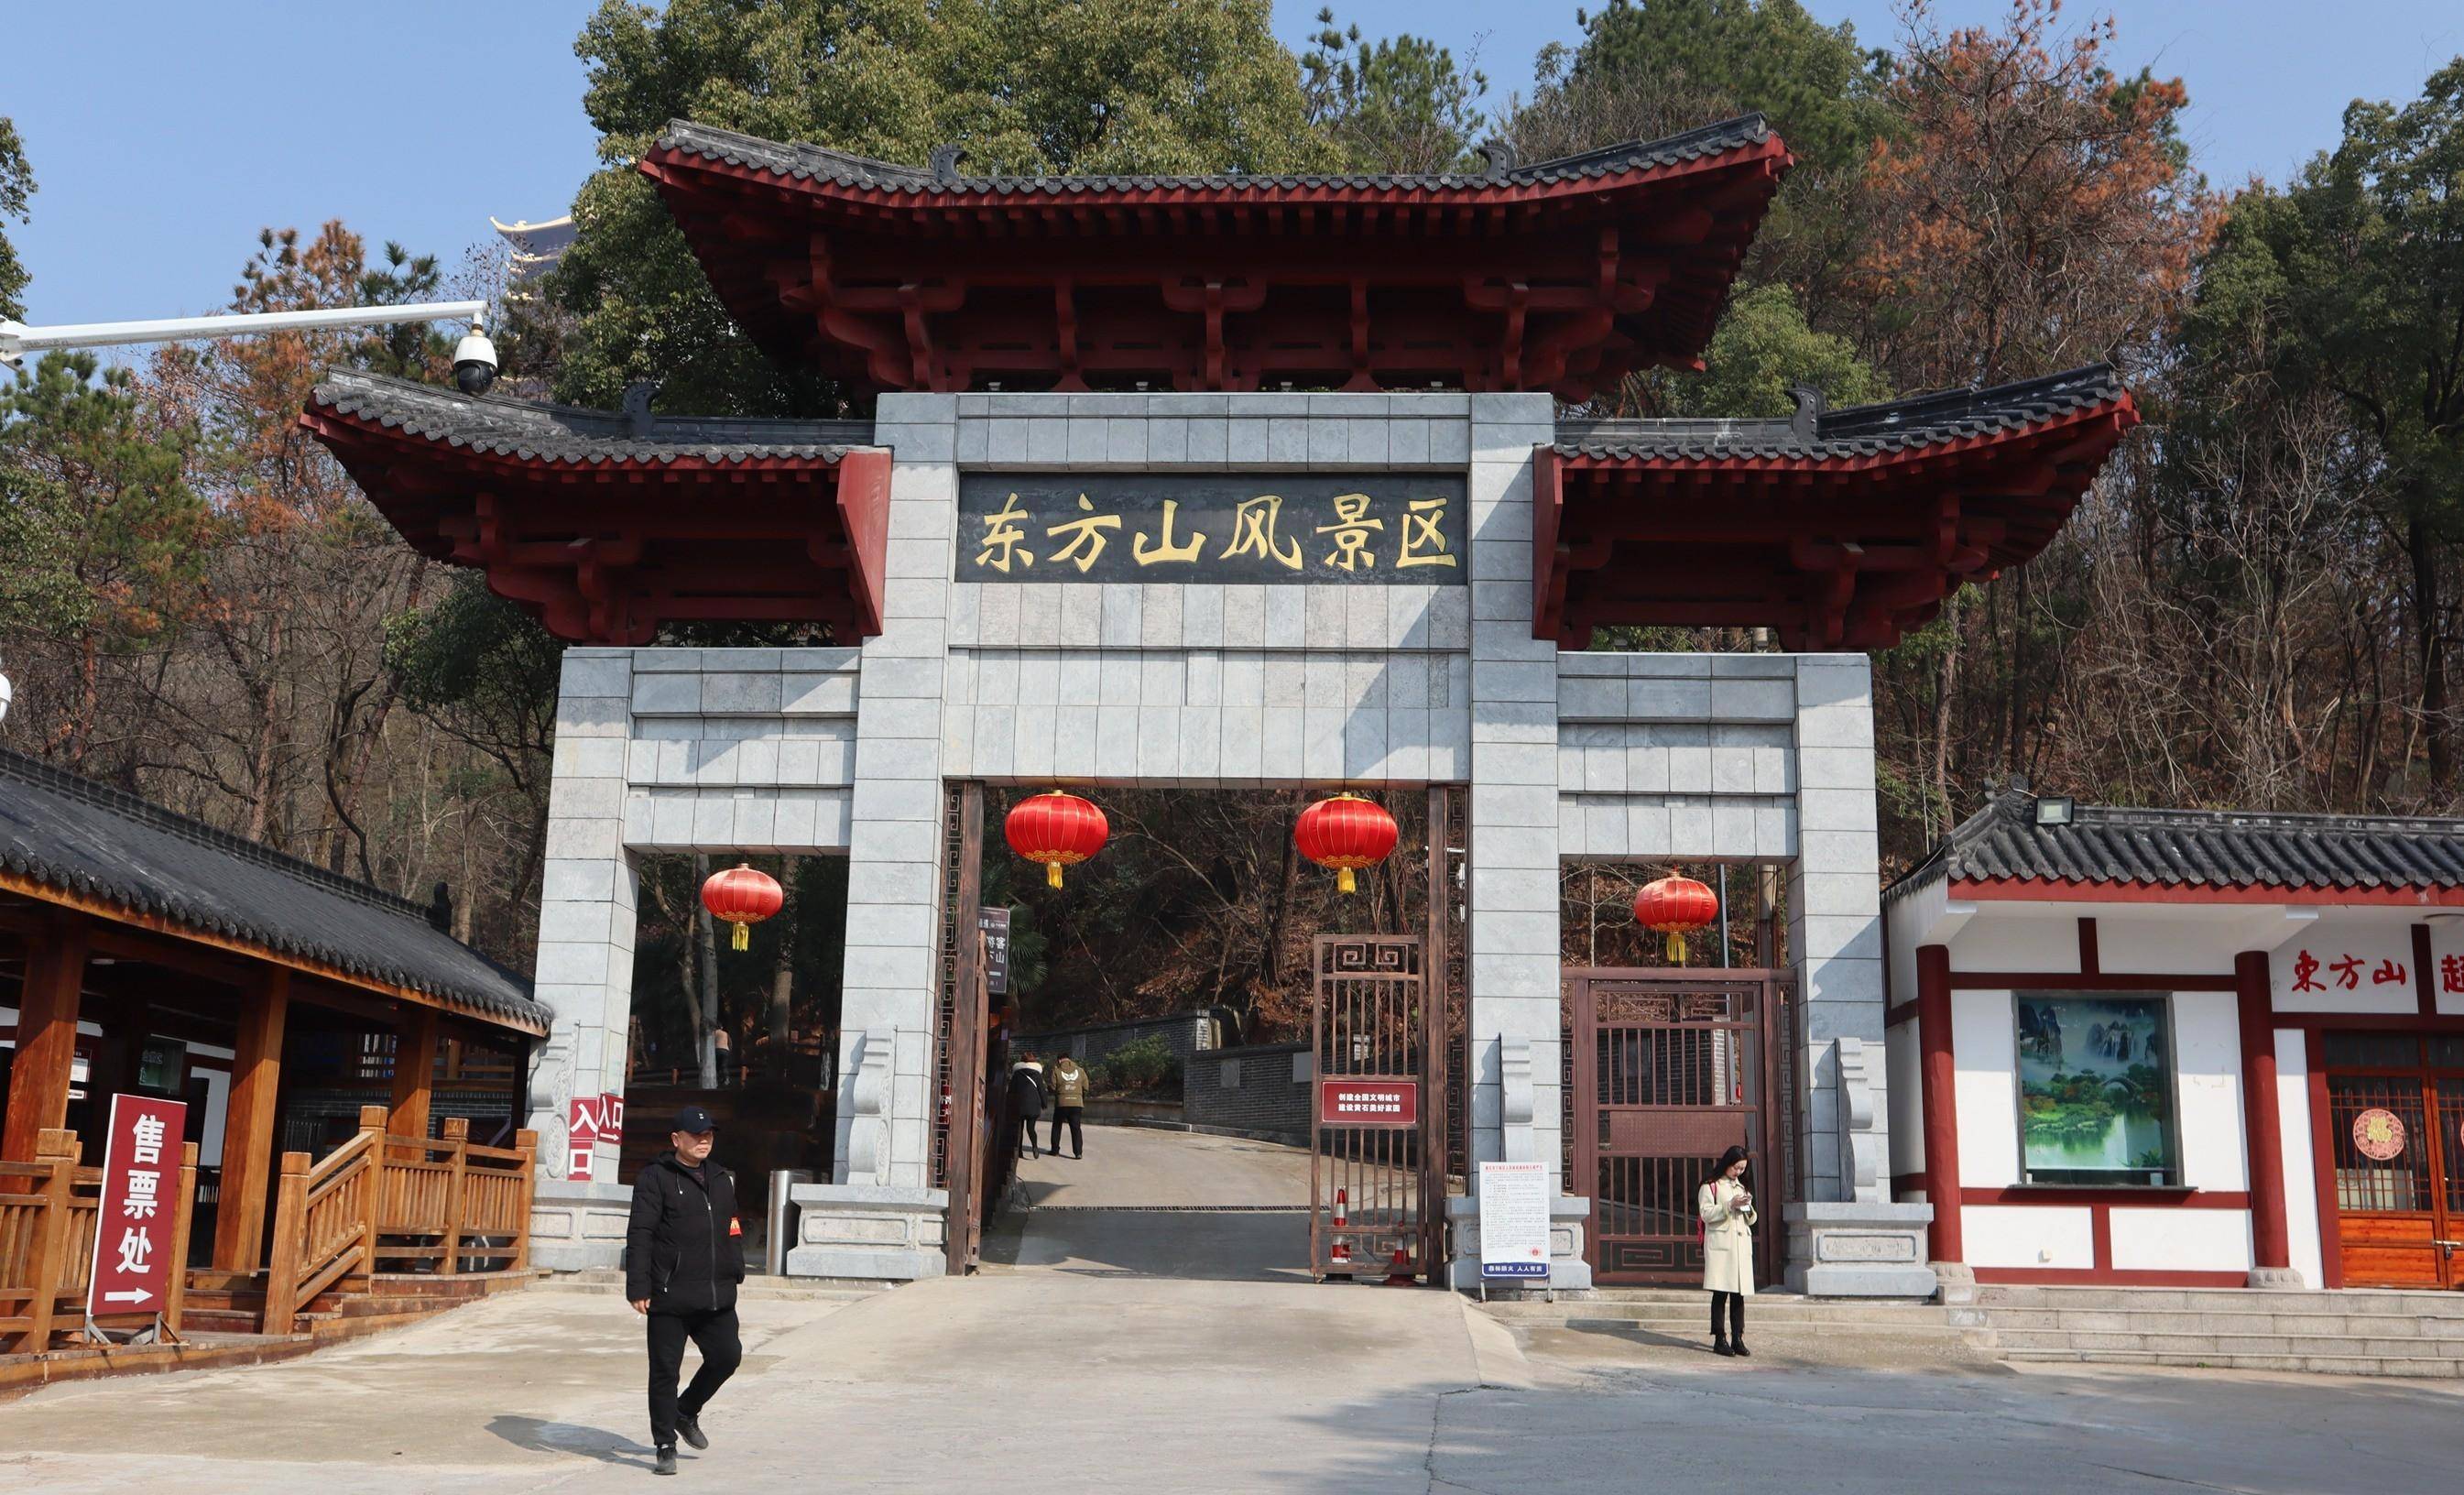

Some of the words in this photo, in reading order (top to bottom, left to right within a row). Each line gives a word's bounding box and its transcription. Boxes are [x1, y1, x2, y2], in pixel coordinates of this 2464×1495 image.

[975, 491, 1458, 573] 东方山风景区
[2291, 949, 2406, 992] 東方山
[598, 1096, 624, 1129] 入口
[1338, 1093, 1401, 1102] 创建全国文明城市
[569, 1103, 599, 1174] 入口
[115, 1113, 166, 1274] 售票处
